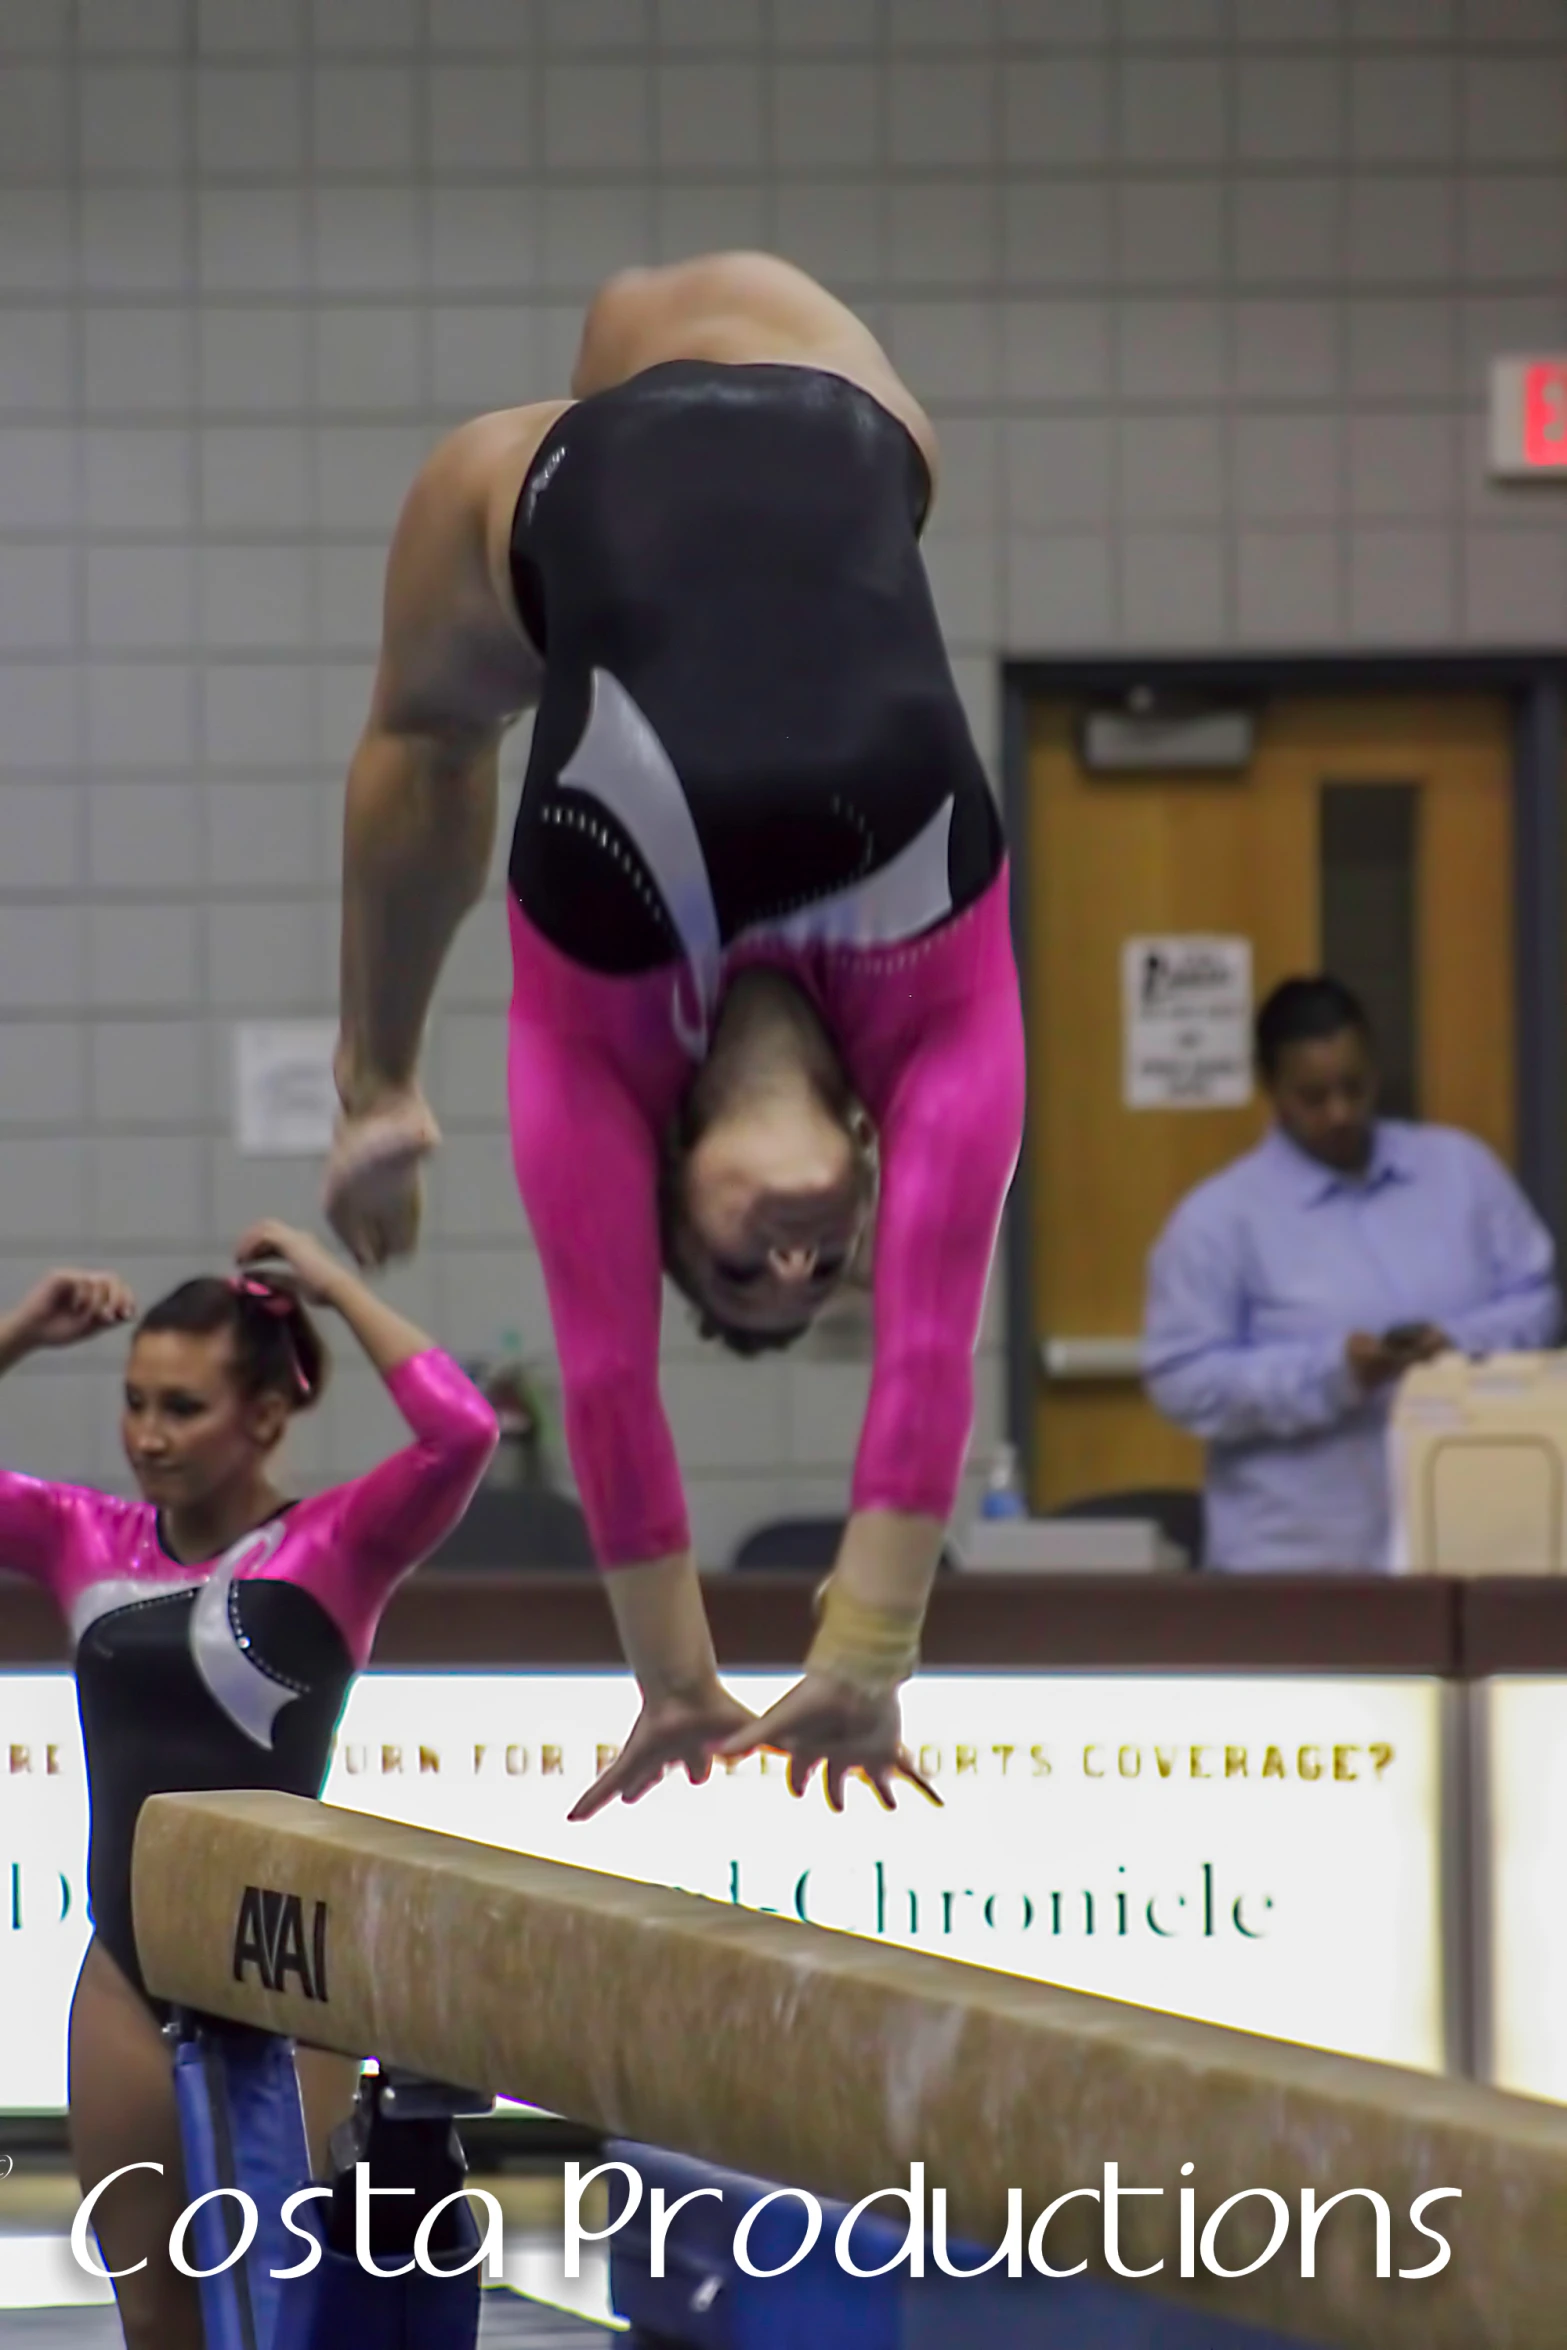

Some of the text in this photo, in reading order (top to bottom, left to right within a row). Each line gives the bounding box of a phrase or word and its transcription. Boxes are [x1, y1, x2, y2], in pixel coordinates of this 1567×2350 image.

[333, 1743, 440, 1776] URN
[473, 1743, 564, 1776] FOR
[916, 1743, 1052, 1778] ORTS
[1082, 1743, 1395, 1781] COVERAGE?
